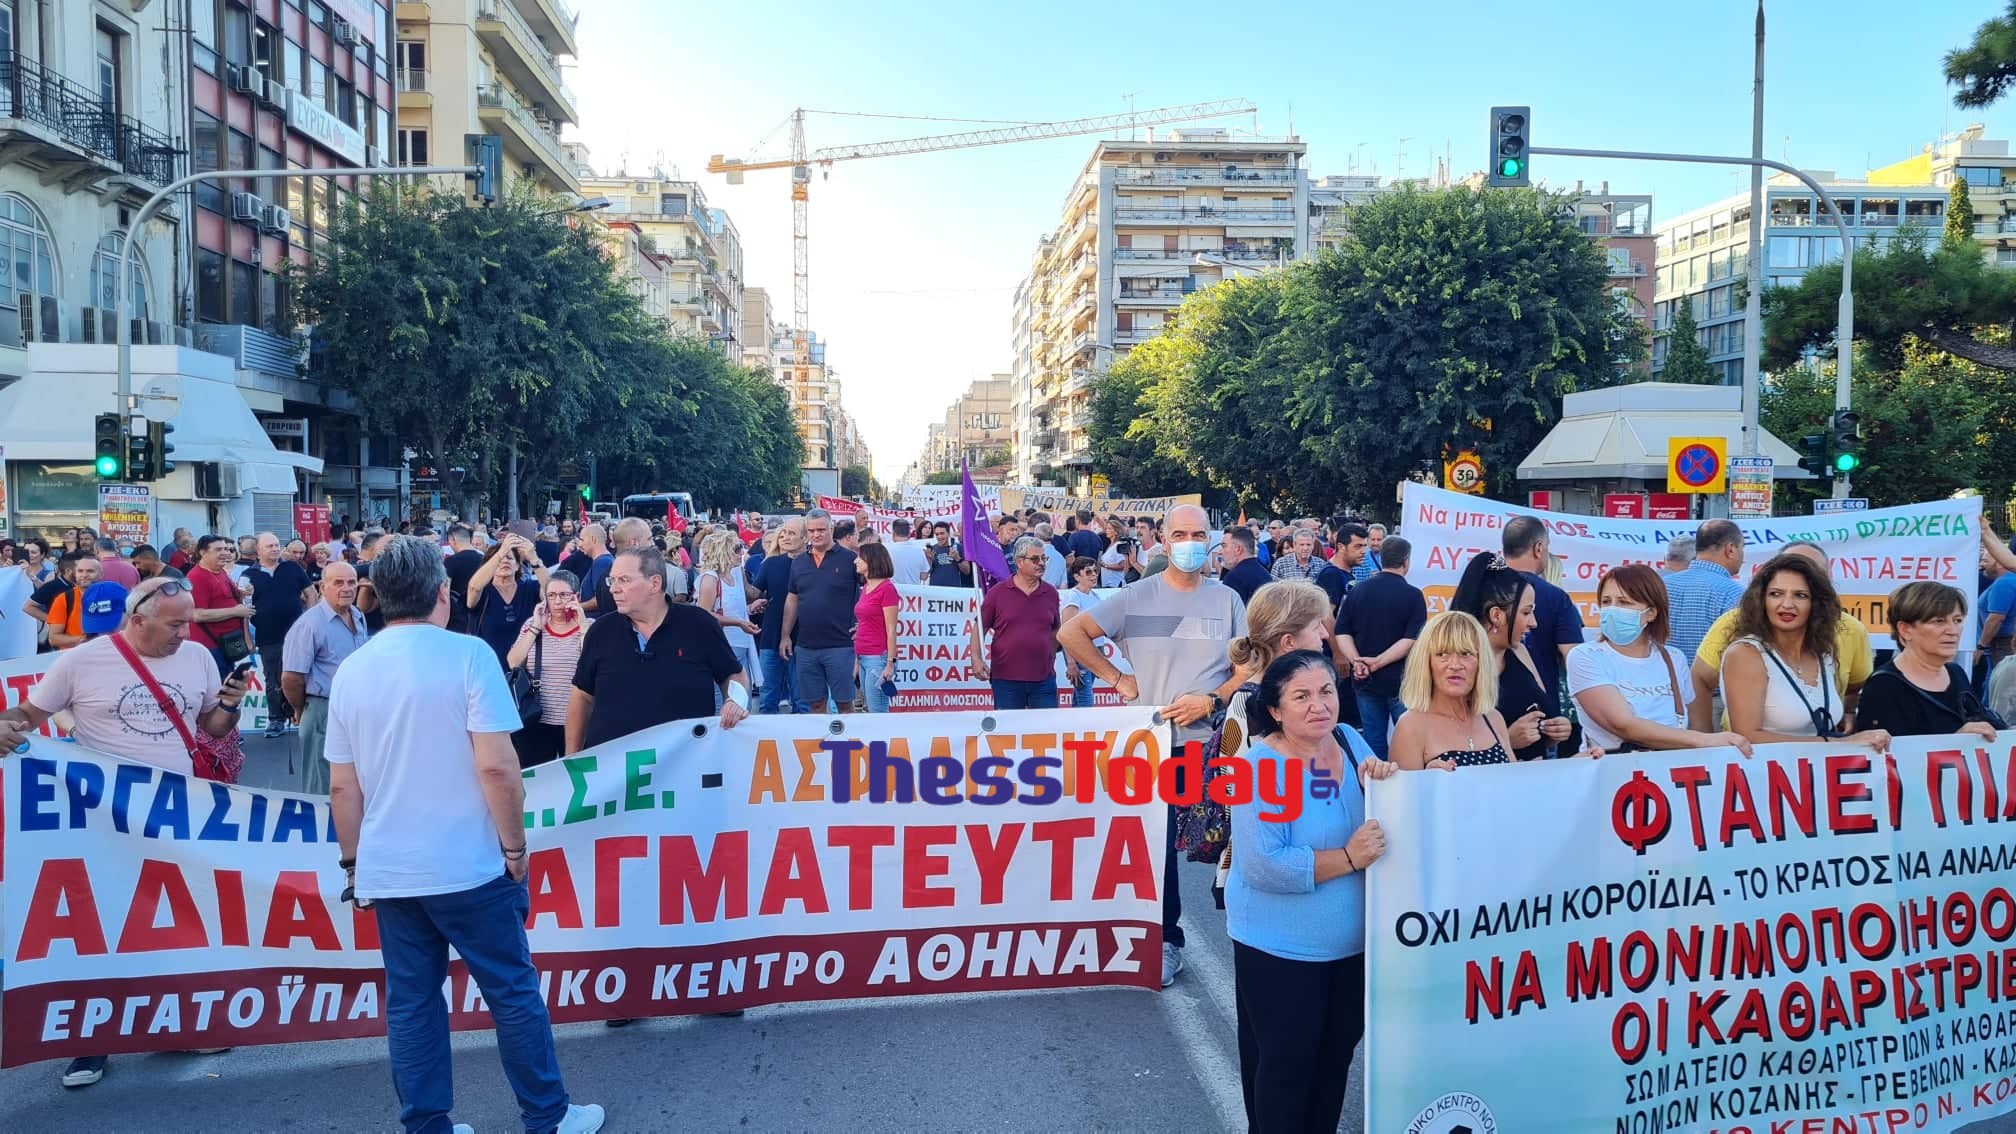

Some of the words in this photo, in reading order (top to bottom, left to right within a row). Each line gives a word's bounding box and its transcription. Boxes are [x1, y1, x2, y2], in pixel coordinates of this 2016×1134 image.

[1456, 469, 1474, 481] 30
[936, 503, 961, 516] ΩΡ
[1419, 504, 1448, 524] Να
[1456, 511, 1502, 530] μπει
[1599, 531, 1646, 545] στην
[1856, 514, 1969, 538] ΦΤΩΧΕΙΑ
[1829, 556, 1957, 580] ΥΝΤΑΞΕΙΣ
[927, 600, 964, 613] ΣΤΗΝ
[927, 623, 957, 636] ΣΤΙΣ
[944, 695, 994, 706] ΟΜΟΣΠΟΝ
[20, 757, 338, 842] ΕΡΓΑΣΙΑ
[1611, 754, 1903, 856] ΦΤΑΝΕΙ
[15, 815, 1158, 962] ΑΔΙΑΑΓΜΑΤΕΥΤΑ
[1395, 909, 1460, 948] ΟΧΙ
[1470, 894, 1552, 939] ΑΛΛΗ
[1562, 869, 1716, 923] ΚΟΡΟΪΔΙΑ
[1735, 867, 1768, 901] ΤΟ
[1776, 855, 1893, 896] ΚΡΑΤΟΣ
[1897, 851, 1932, 882] ΝΑ
[651, 949, 845, 1000] ΚΕΝΤΡΟ
[867, 926, 1148, 985] ΑΘΗΝΑΣ
[1464, 950, 1547, 1025] ΝΑ
[1611, 997, 1669, 1065] ΟΙ
[1625, 1052, 1747, 1105] ΣΩΜΑΤΕΙΟ
[1759, 1027, 1930, 1078] ΚΑΘΑΡΙΣΤΡΙΩΝ
[1935, 1023, 1945, 1050] &
[1436, 1095, 1480, 1113] ΚΕΝΤΡΟ
[1616, 1095, 1699, 1134] ΝΟΜΩΝ
[1710, 1081, 1839, 1121] ΚΟΖΑΝΗΣ
[1861, 1053, 1965, 1104] ΓΡΕΒΕΝΩΝ
